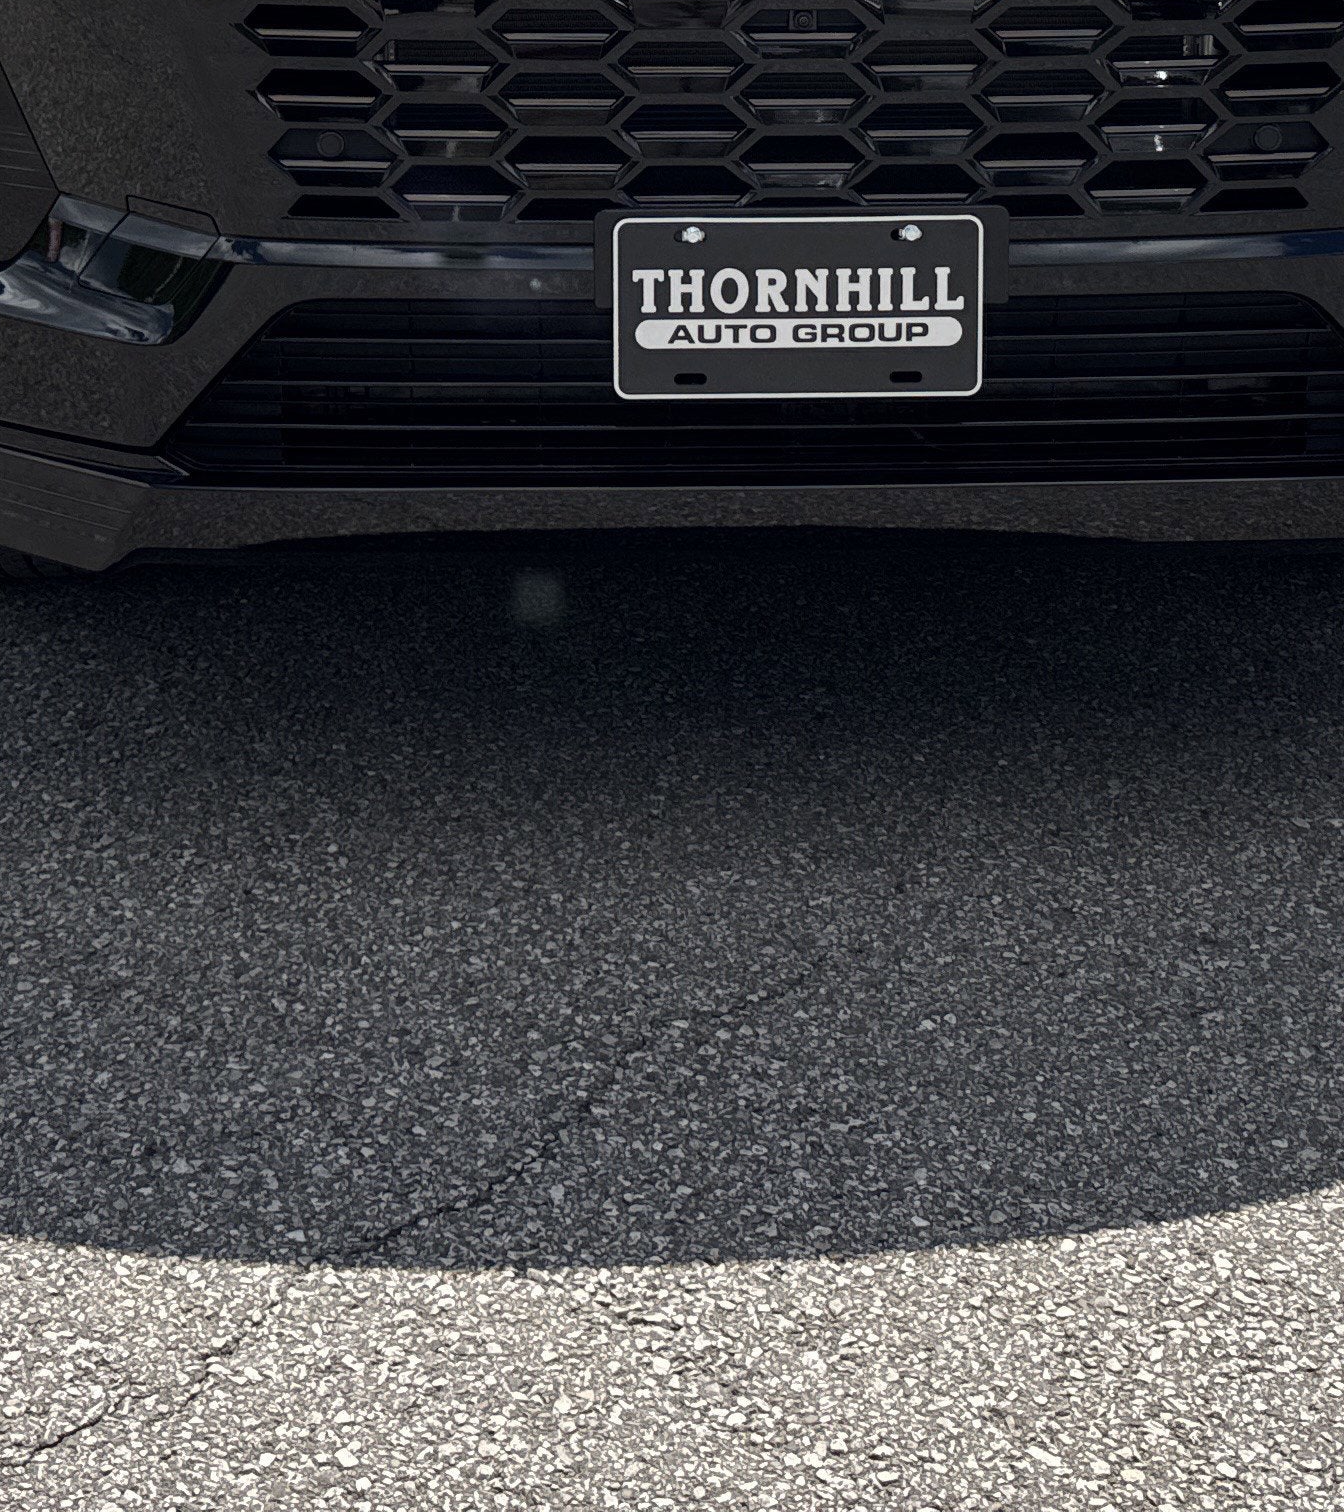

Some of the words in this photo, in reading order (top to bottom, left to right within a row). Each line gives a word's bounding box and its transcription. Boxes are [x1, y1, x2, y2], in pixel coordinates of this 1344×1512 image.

[631, 266, 965, 314] THORNHILL
[668, 324, 777, 344] AUTO
[791, 321, 930, 343] GROUP
